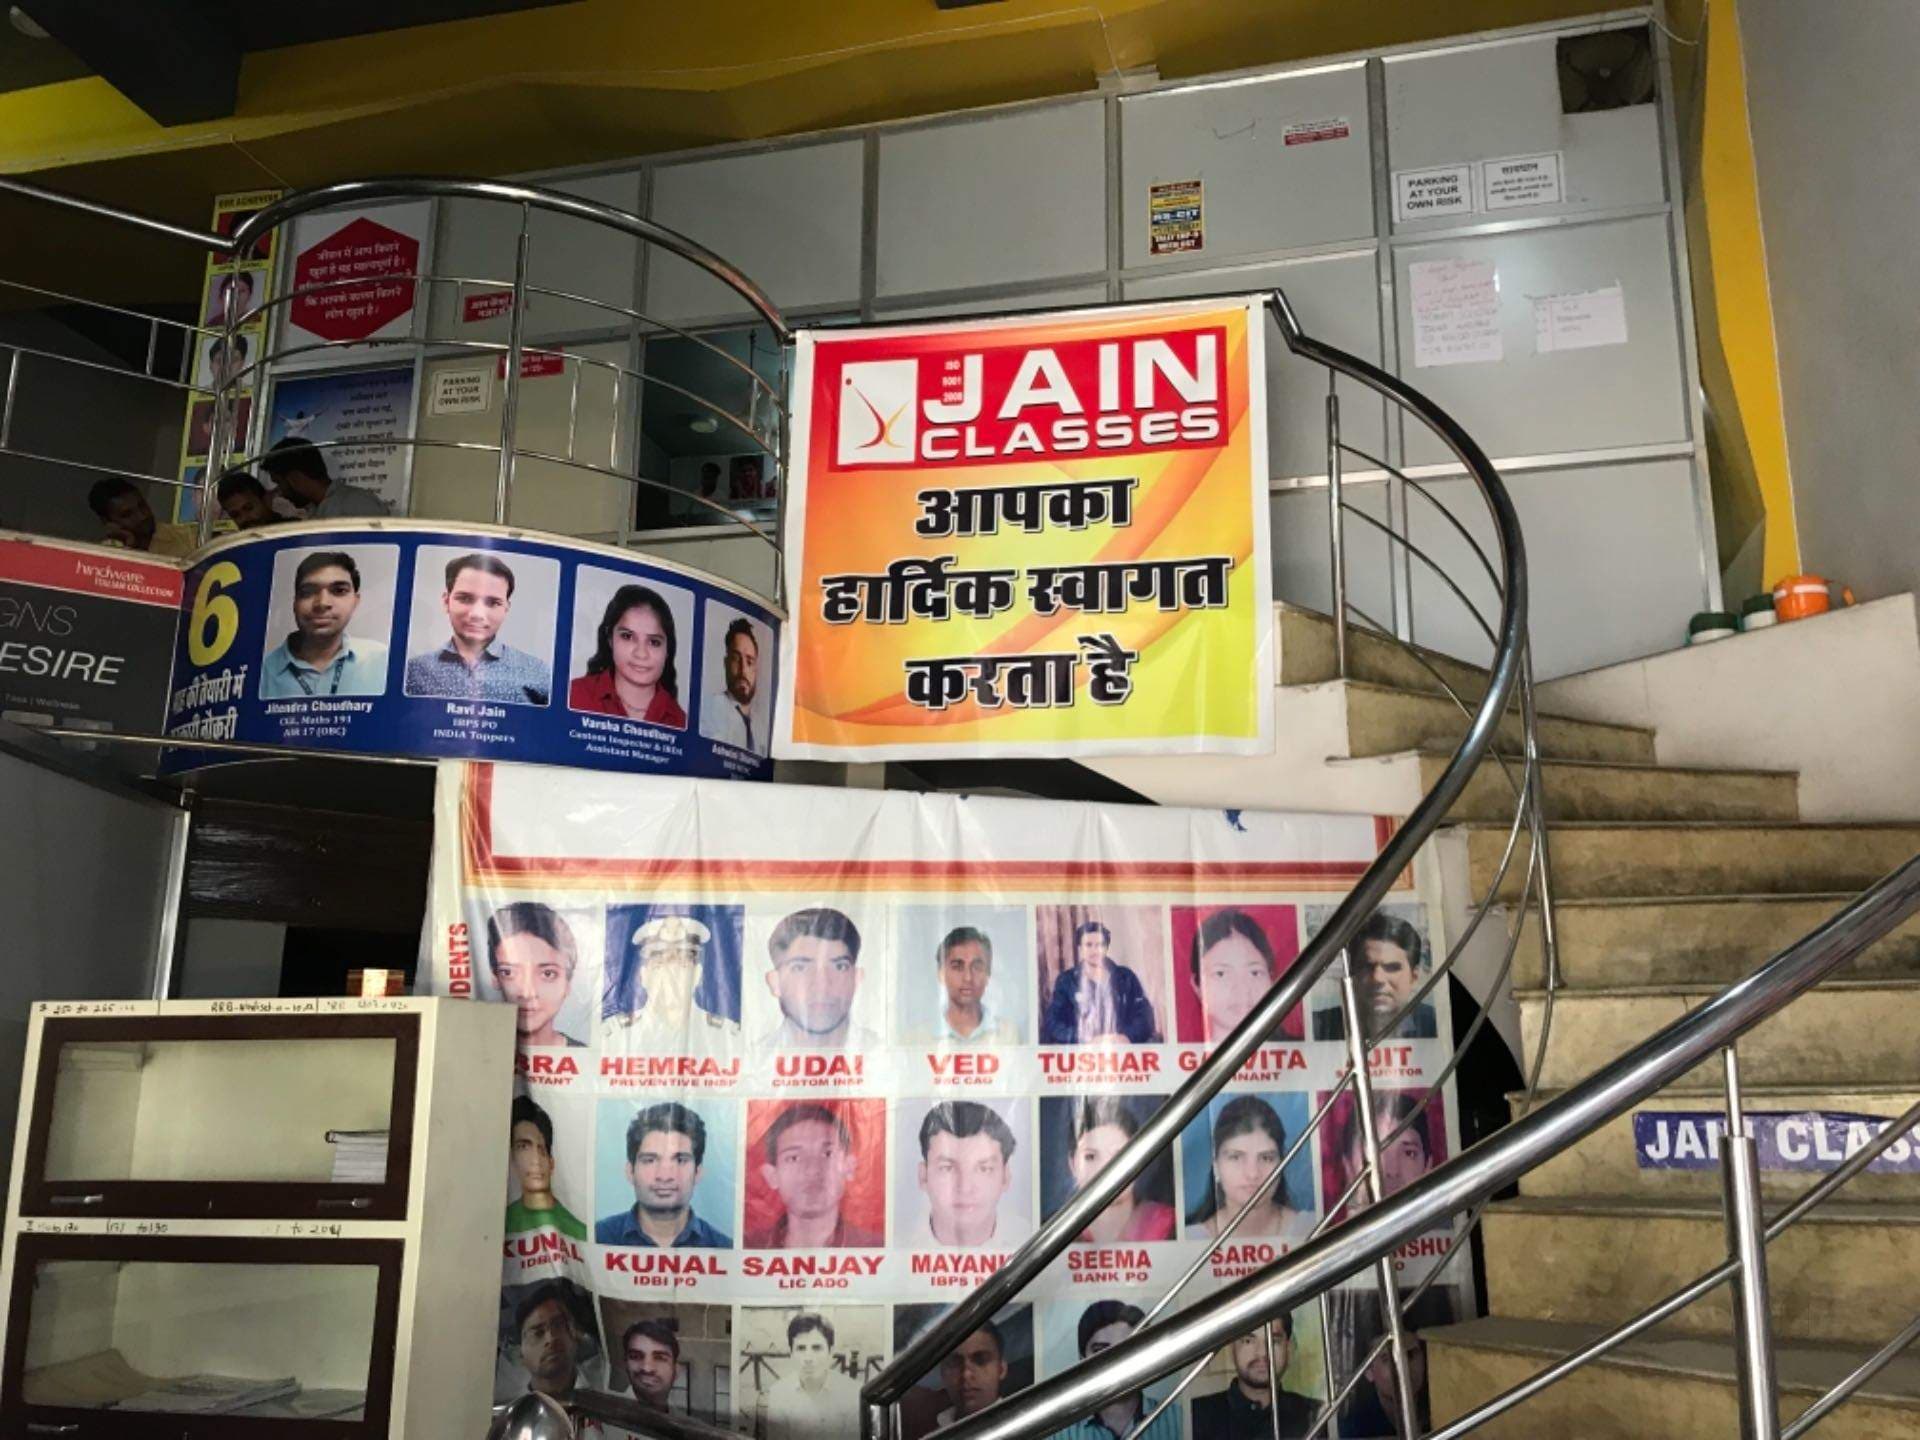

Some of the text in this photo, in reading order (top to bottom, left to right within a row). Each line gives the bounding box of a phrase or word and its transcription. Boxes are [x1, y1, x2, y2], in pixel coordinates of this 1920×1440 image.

[1408, 174, 1458, 188] PARKING
[1407, 196, 1462, 210] OWN RISK
[1409, 187, 1459, 199] AT YOUR
[442, 374, 481, 386] PARKING
[922, 333, 1218, 425] JAIN
[456, 386, 479, 395] YOUR
[920, 406, 1221, 461] CLASSES
[914, 477, 1138, 538] आपका
[75, 560, 145, 584] hindware
[126, 583, 175, 598] COLLECTION
[820, 556, 1235, 625] हार्दिक स्वागत
[188, 561, 243, 668] 6
[0, 641, 125, 685] ESIRE
[904, 633, 1139, 711] करता है
[232, 664, 248, 699] में
[446, 702, 506, 718] Ravi Jain
[200, 705, 239, 741] नौकरी
[453, 718, 498, 730] IBPS PO
[581, 716, 620, 733] Varsha
[433, 728, 516, 743] INDIA Toppers
[585, 742, 671, 764] Assistant Manager
[448, 923, 471, 999] DENTS
[600, 1055, 741, 1077] HEMRAJ
[775, 1054, 865, 1077] UDAI
[927, 1053, 1000, 1075] VED
[1038, 1052, 1160, 1074] TUSHAR
[1178, 1048, 1307, 1072] GVITA
[1346, 1046, 1412, 1068] JIT
[609, 1078, 700, 1088] PREVENTIVE
[772, 1077, 830, 1087] CUSTOM
[1645, 1119, 1753, 1160] JAI
[503, 1231, 585, 1264] KUNAL
[604, 1252, 729, 1276] KUNAL
[741, 1255, 886, 1277] SANJAY
[1067, 1249, 1153, 1271] SEEMA
[633, 1275, 698, 1288] IDBI PO
[778, 1277, 849, 1289] LIC ADO
[931, 1276, 969, 1287] IBPS
[1072, 1271, 1149, 1284] BANK PO
